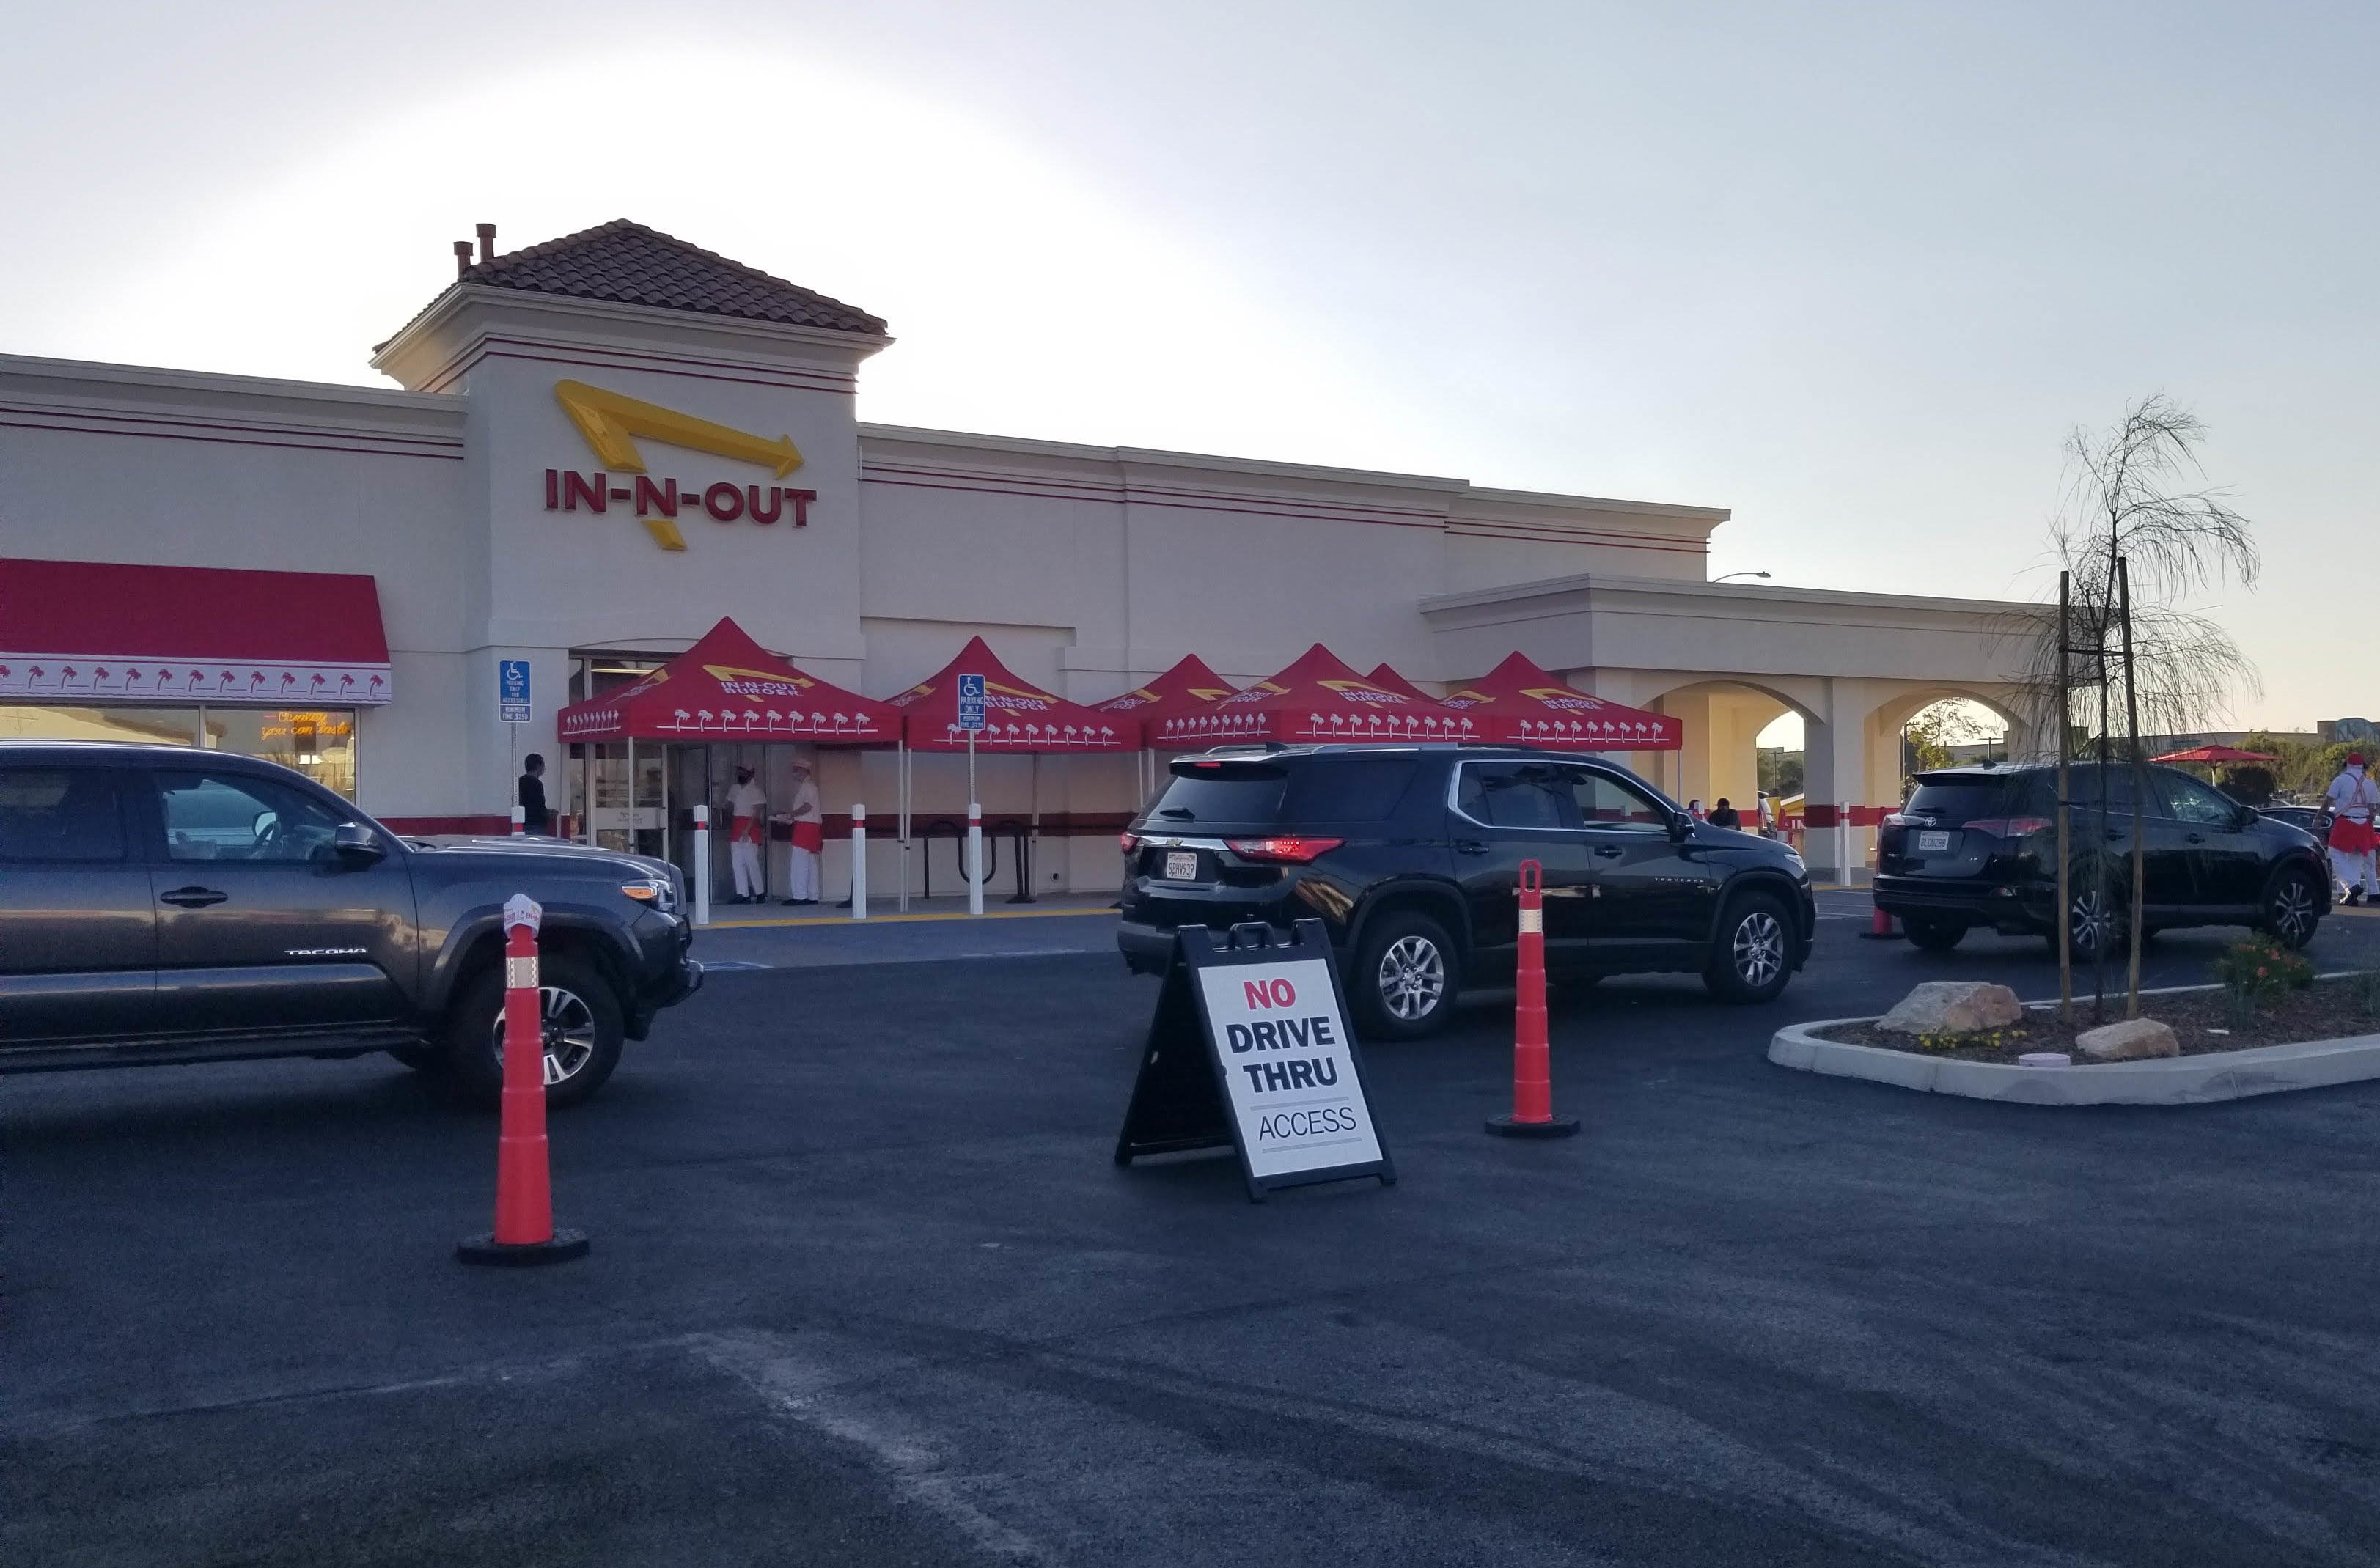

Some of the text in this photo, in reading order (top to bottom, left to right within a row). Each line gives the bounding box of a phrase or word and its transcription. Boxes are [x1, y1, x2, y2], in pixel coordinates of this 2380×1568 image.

[546, 468, 817, 526] IN-N-OUT
[721, 682, 796, 690] IN-N-OUT
[961, 696, 983, 704] PARKING
[985, 695, 1045, 705] N-N-OUT
[965, 705, 980, 713] ONLY
[1243, 978, 1296, 1010] NO
[1225, 1016, 1335, 1054] DRIVE
[1242, 1056, 1338, 1093] THRU
[1259, 1107, 1356, 1141] ACCESS
